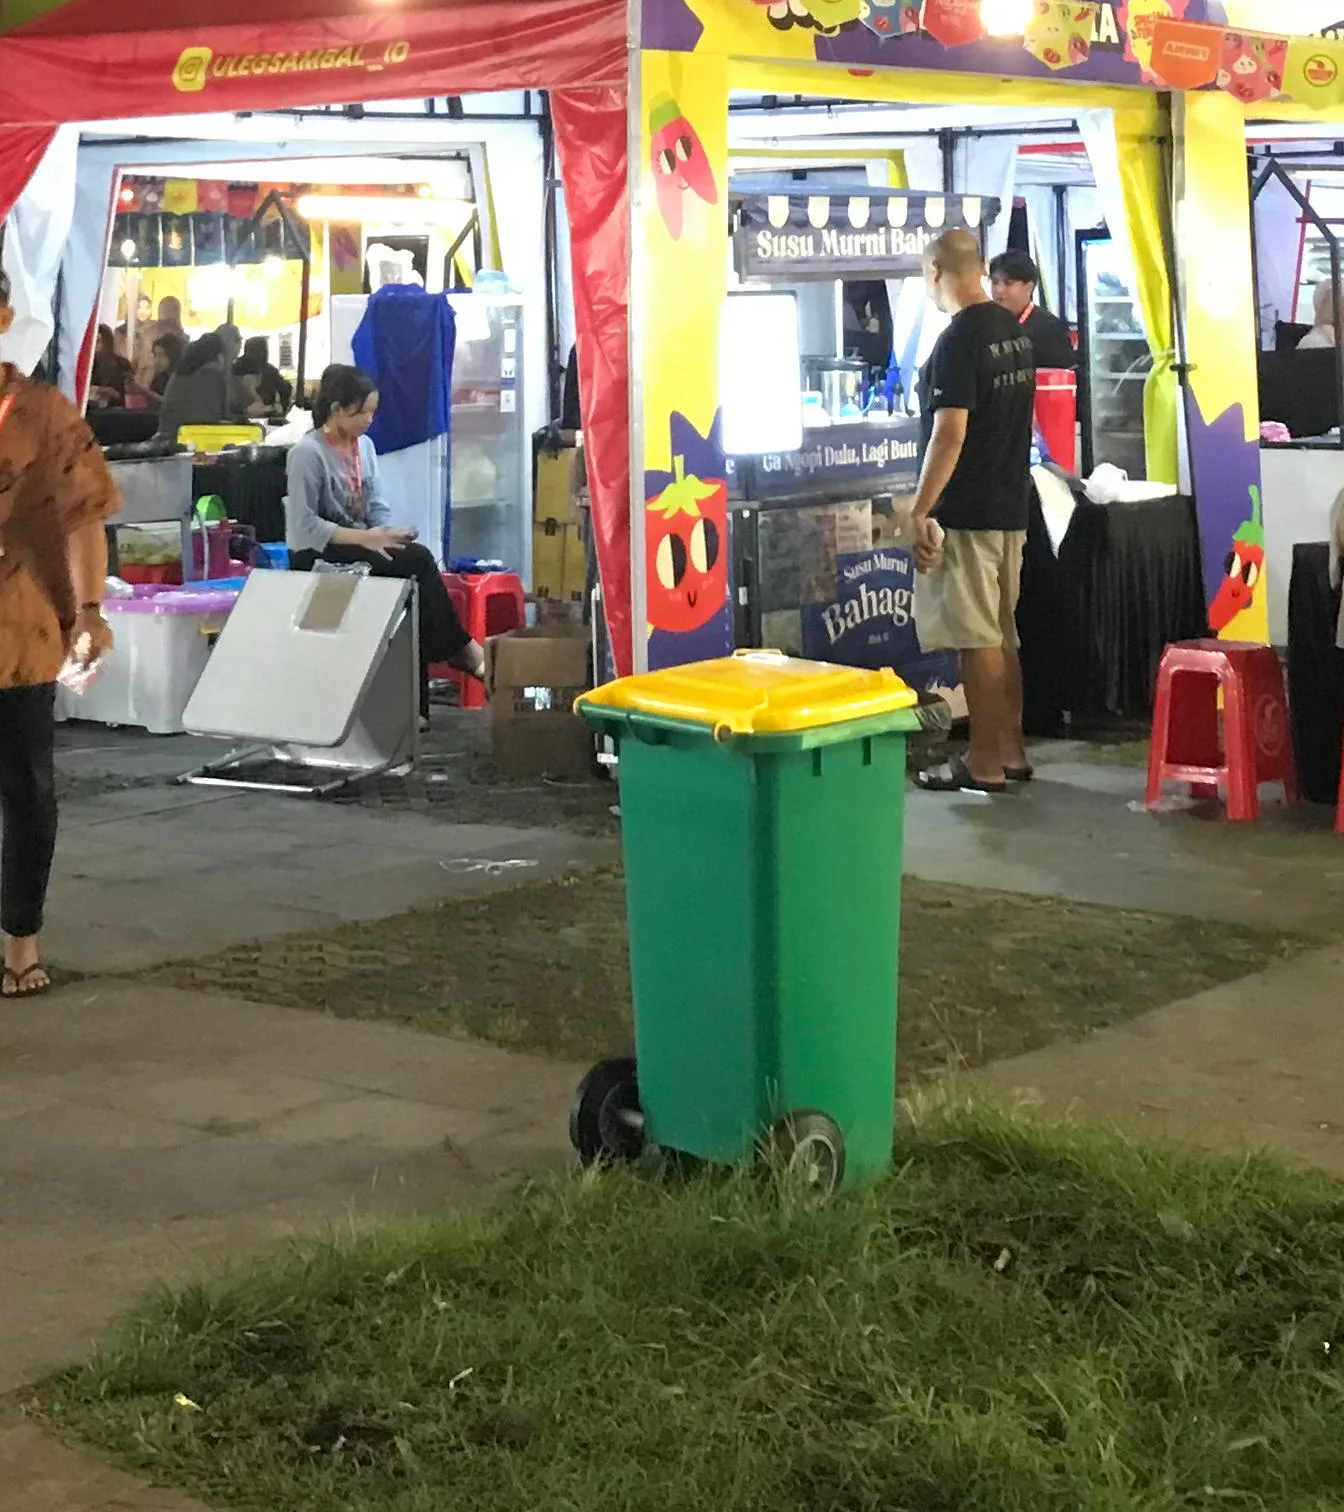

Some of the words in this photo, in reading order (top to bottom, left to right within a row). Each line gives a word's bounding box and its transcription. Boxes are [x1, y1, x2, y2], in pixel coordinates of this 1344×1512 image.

[757, 230, 813, 258] Susu
[819, 226, 886, 257] Murni
[862, 439, 888, 468] Lagi
[843, 558, 872, 583] Susu
[872, 553, 909, 576] Murni
